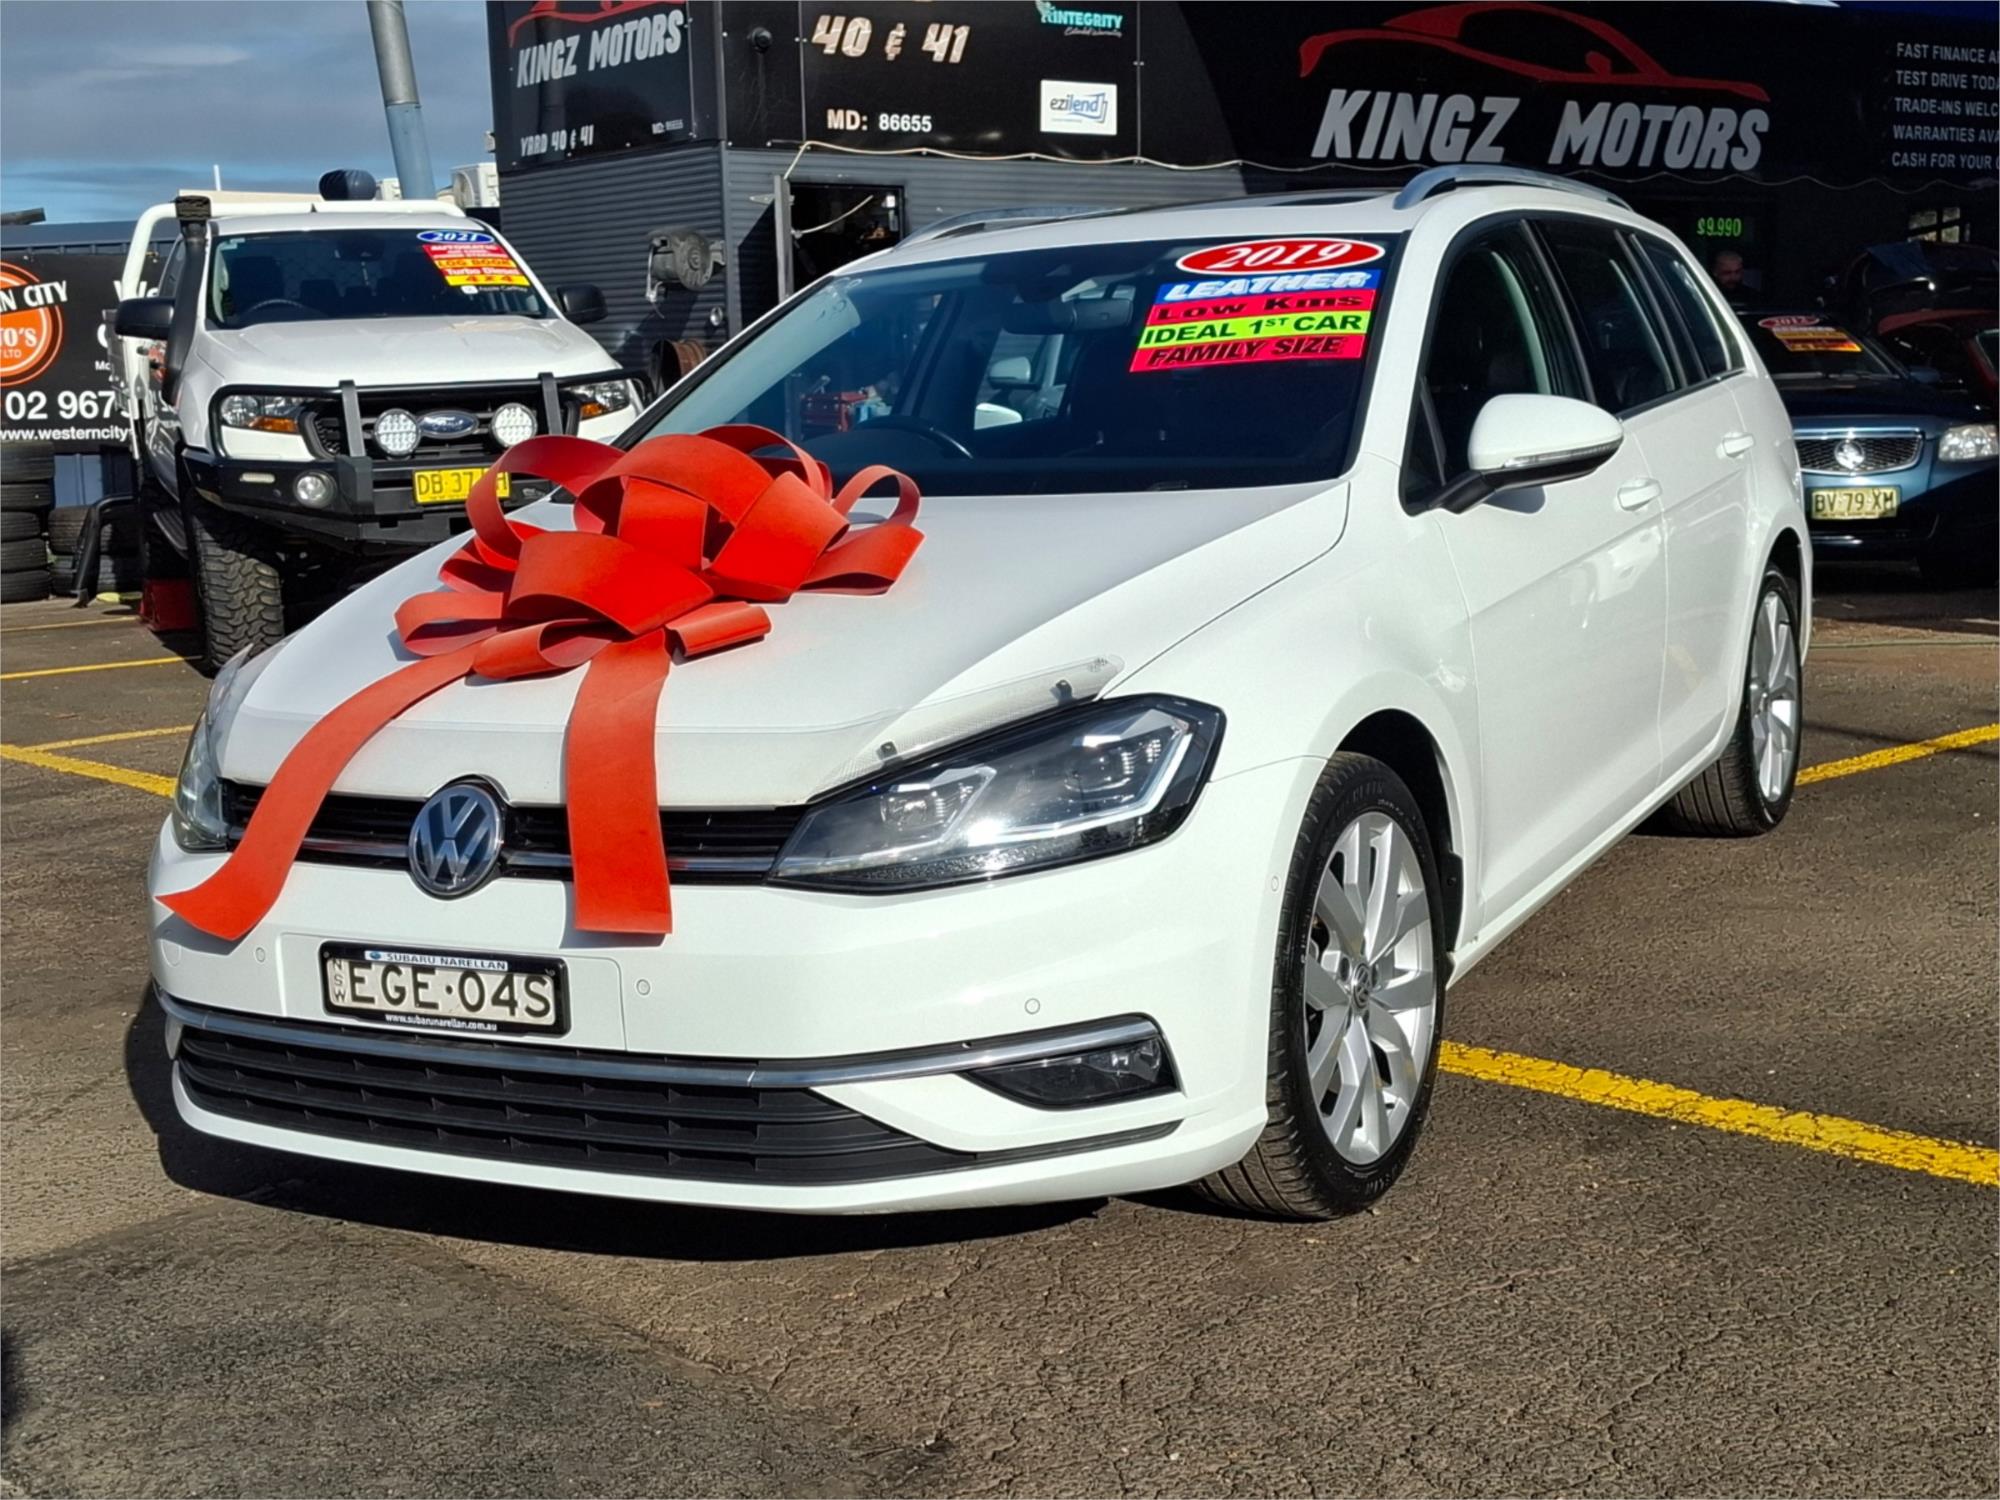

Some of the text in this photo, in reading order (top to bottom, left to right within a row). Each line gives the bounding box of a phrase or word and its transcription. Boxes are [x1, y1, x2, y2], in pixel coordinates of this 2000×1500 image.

[516, 9, 684, 88] KINGZ MOTORS
[811, 15, 872, 57] 40
[922, 23, 970, 63] 41
[1896, 42, 1928, 58] FAST
[1932, 46, 1985, 63] FINANCE
[1896, 70, 1928, 86] TEST
[1931, 72, 1968, 88] DRIVE
[1050, 94, 1100, 112] ezilend
[1894, 97, 1961, 115] TRADE-INS
[827, 109, 932, 132] MD: 86655
[1311, 89, 1769, 170] KINGZ MOTORS
[1893, 124, 1975, 142] WARRANTIES
[551, 130, 567, 151] 40
[580, 124, 594, 146] 41
[1891, 152, 1927, 167] CASH
[1930, 153, 1955, 168] FOR
[1959, 155, 1992, 169] YOUR
[435, 232, 478, 241] 2021
[1206, 243, 1353, 270] 2019
[23, 280, 68, 308] CITY
[1164, 272, 1372, 300] LEATHER
[1144, 324, 1237, 345] IDEAL
[1293, 315, 1363, 331] CAR
[1147, 336, 1346, 367] FAMILY SIZE
[5, 390, 48, 420] 02
[386, 953, 507, 970] SUBARU NARELLAN
[385, 1013, 498, 1032] www.subarunarellan.com.au
